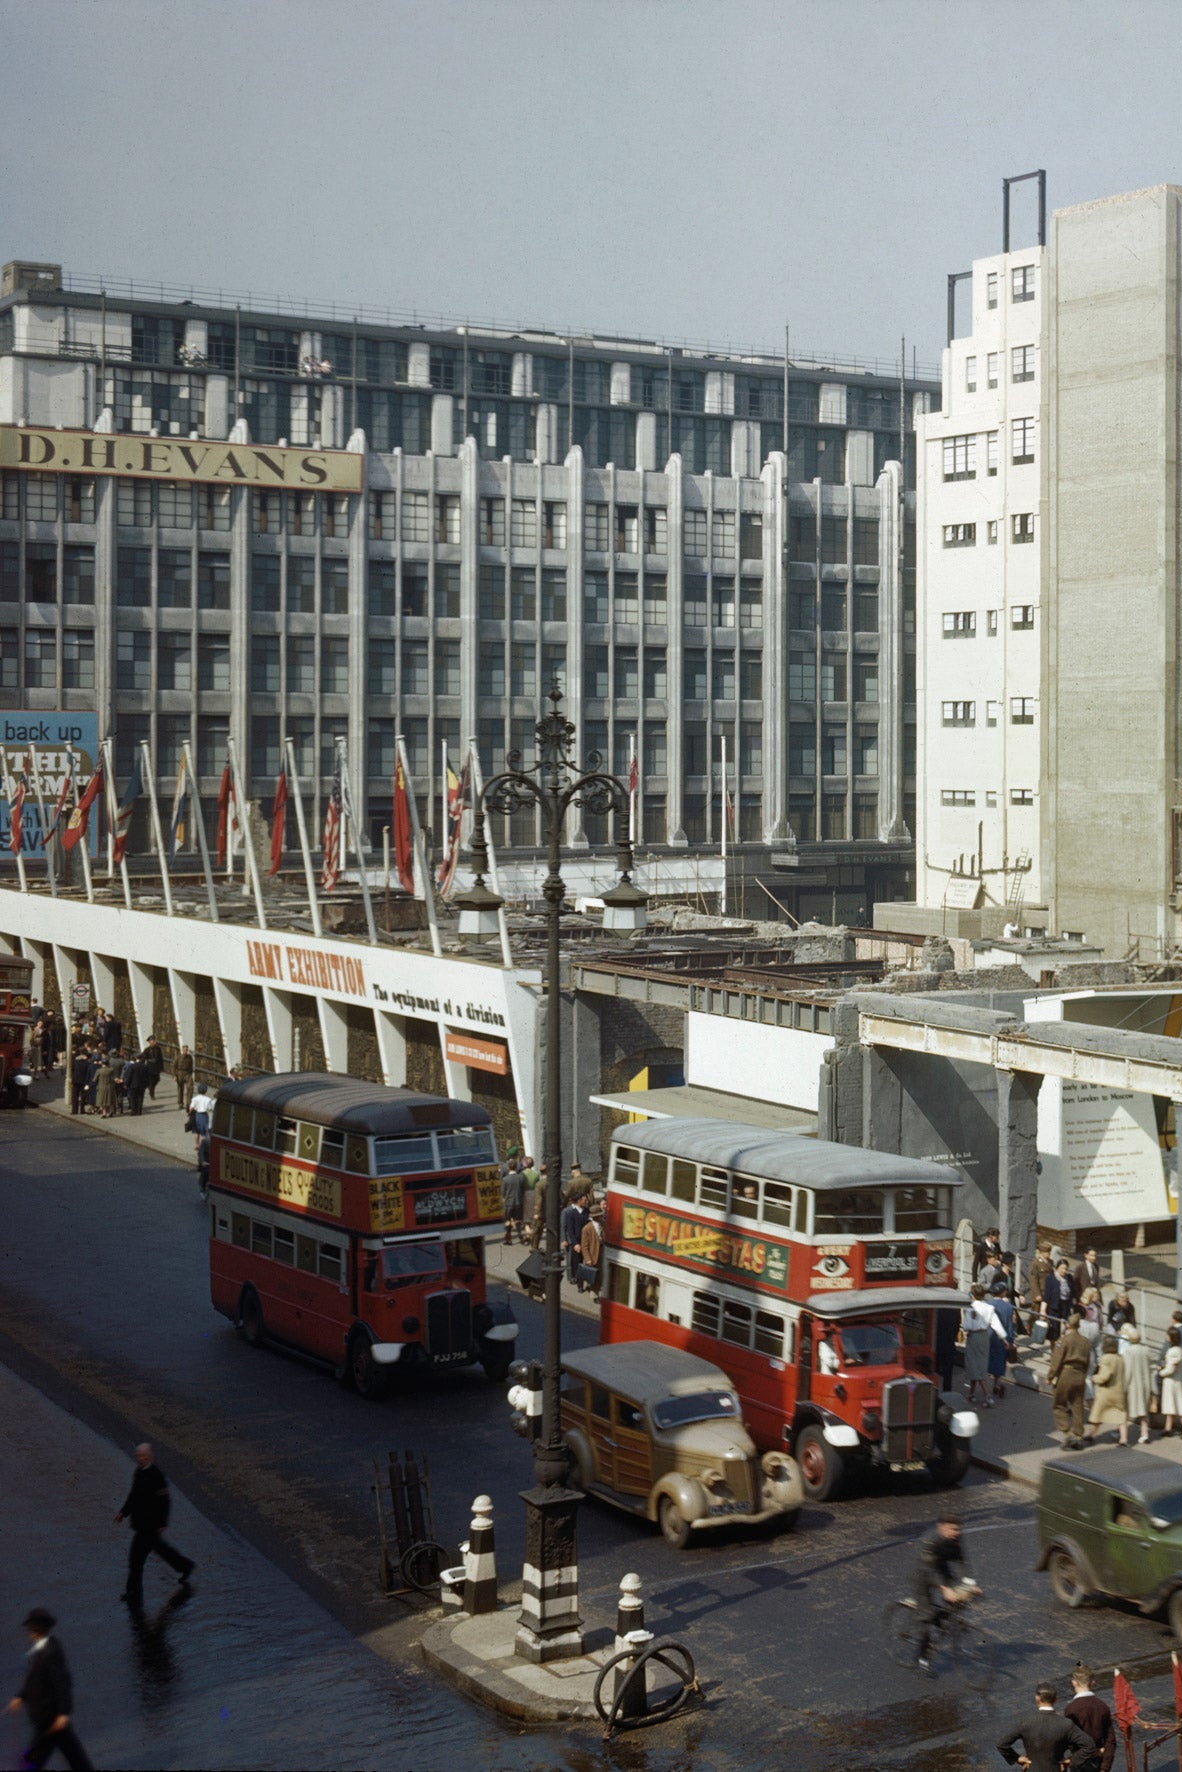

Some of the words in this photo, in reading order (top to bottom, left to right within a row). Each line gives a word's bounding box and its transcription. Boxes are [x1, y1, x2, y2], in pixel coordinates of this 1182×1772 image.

[5, 720, 50, 741] back
[58, 726, 82, 745] up
[7, 752, 82, 772] THE
[246, 939, 284, 981] ARMY
[286, 946, 367, 997] EXHIBITION
[373, 983, 388, 1001] The
[392, 989, 440, 1013] equipment
[443, 998, 453, 1016] of
[456, 1004, 463, 1018] a
[466, 1002, 506, 1028] division
[1077, 1095, 1099, 1103] London
[1111, 1093, 1134, 1101] Moscow
[933, 1153, 948, 1161] LEWIS
[225, 1151, 259, 1187] POULTON
[296, 1172, 334, 1197] QUALITY
[477, 1171, 500, 1182] BLAC
[479, 1185, 501, 1197] WHIT
[308, 1191, 334, 1212] FOODS
[415, 1196, 465, 1210] ALDWYCH
